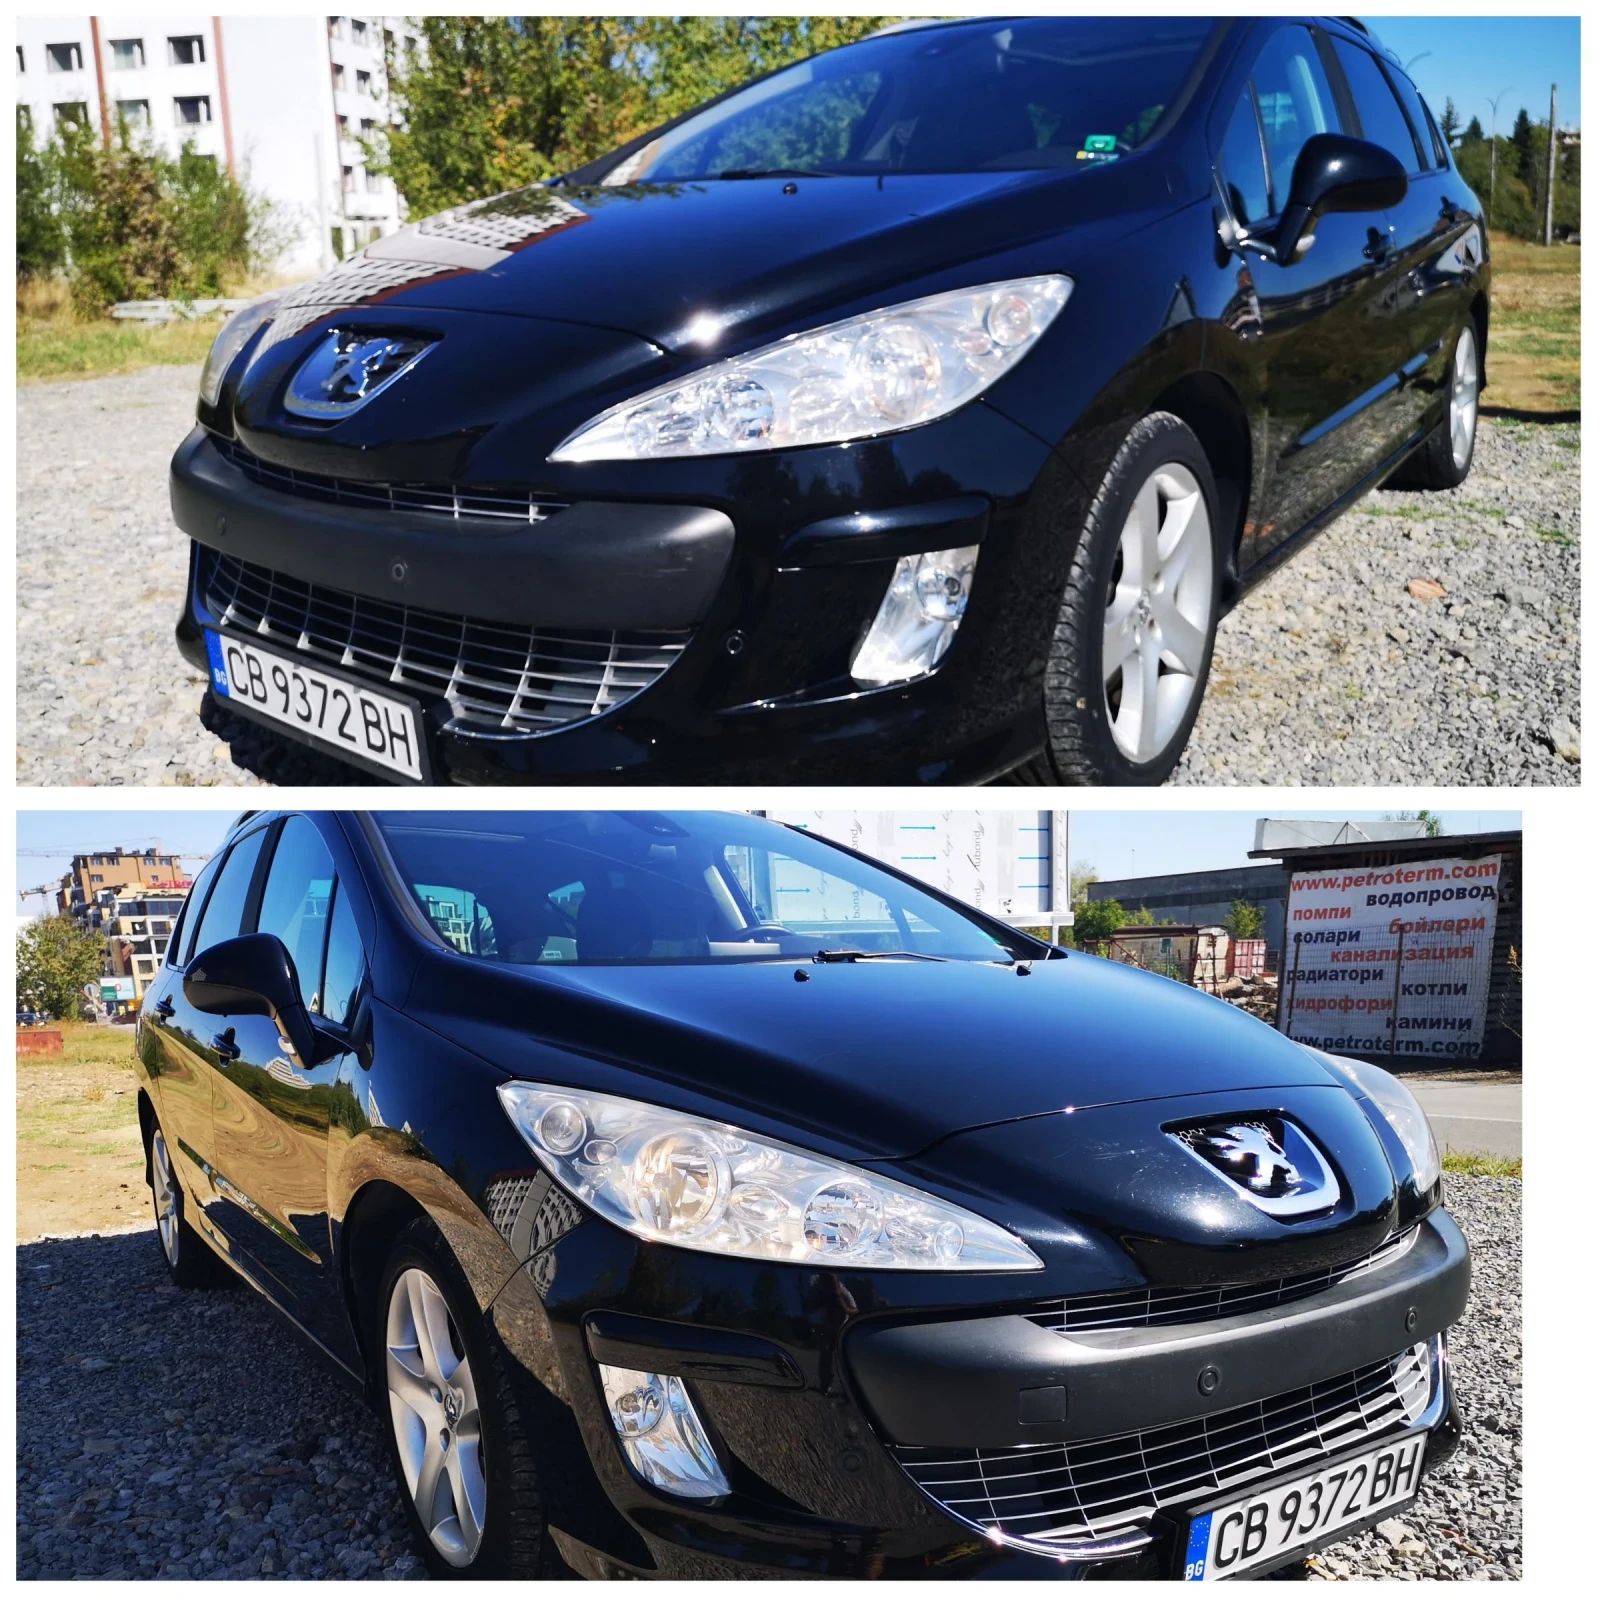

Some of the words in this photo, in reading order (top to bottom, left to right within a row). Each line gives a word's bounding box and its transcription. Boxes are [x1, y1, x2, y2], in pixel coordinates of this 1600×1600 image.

[215, 668, 227, 686] BG
[228, 647, 268, 703] CB
[272, 665, 357, 743] 9372
[359, 697, 413, 767] BH
[1291, 862, 1498, 891] www.petroterm.com
[1366, 885, 1496, 908] водопровод
[1293, 905, 1351, 920] помпи
[1389, 916, 1486, 936] бойлери
[1293, 929, 1361, 946] солари
[1330, 945, 1474, 963] канализация
[1286, 969, 1384, 985] радиатори
[1401, 982, 1467, 996] котли
[1386, 1016, 1472, 1031] камини
[1215, 1502, 1269, 1568] CB
[1279, 1463, 1368, 1545] 9372
[1369, 1440, 1421, 1507] BH
[1185, 1559, 1204, 1580] BG
